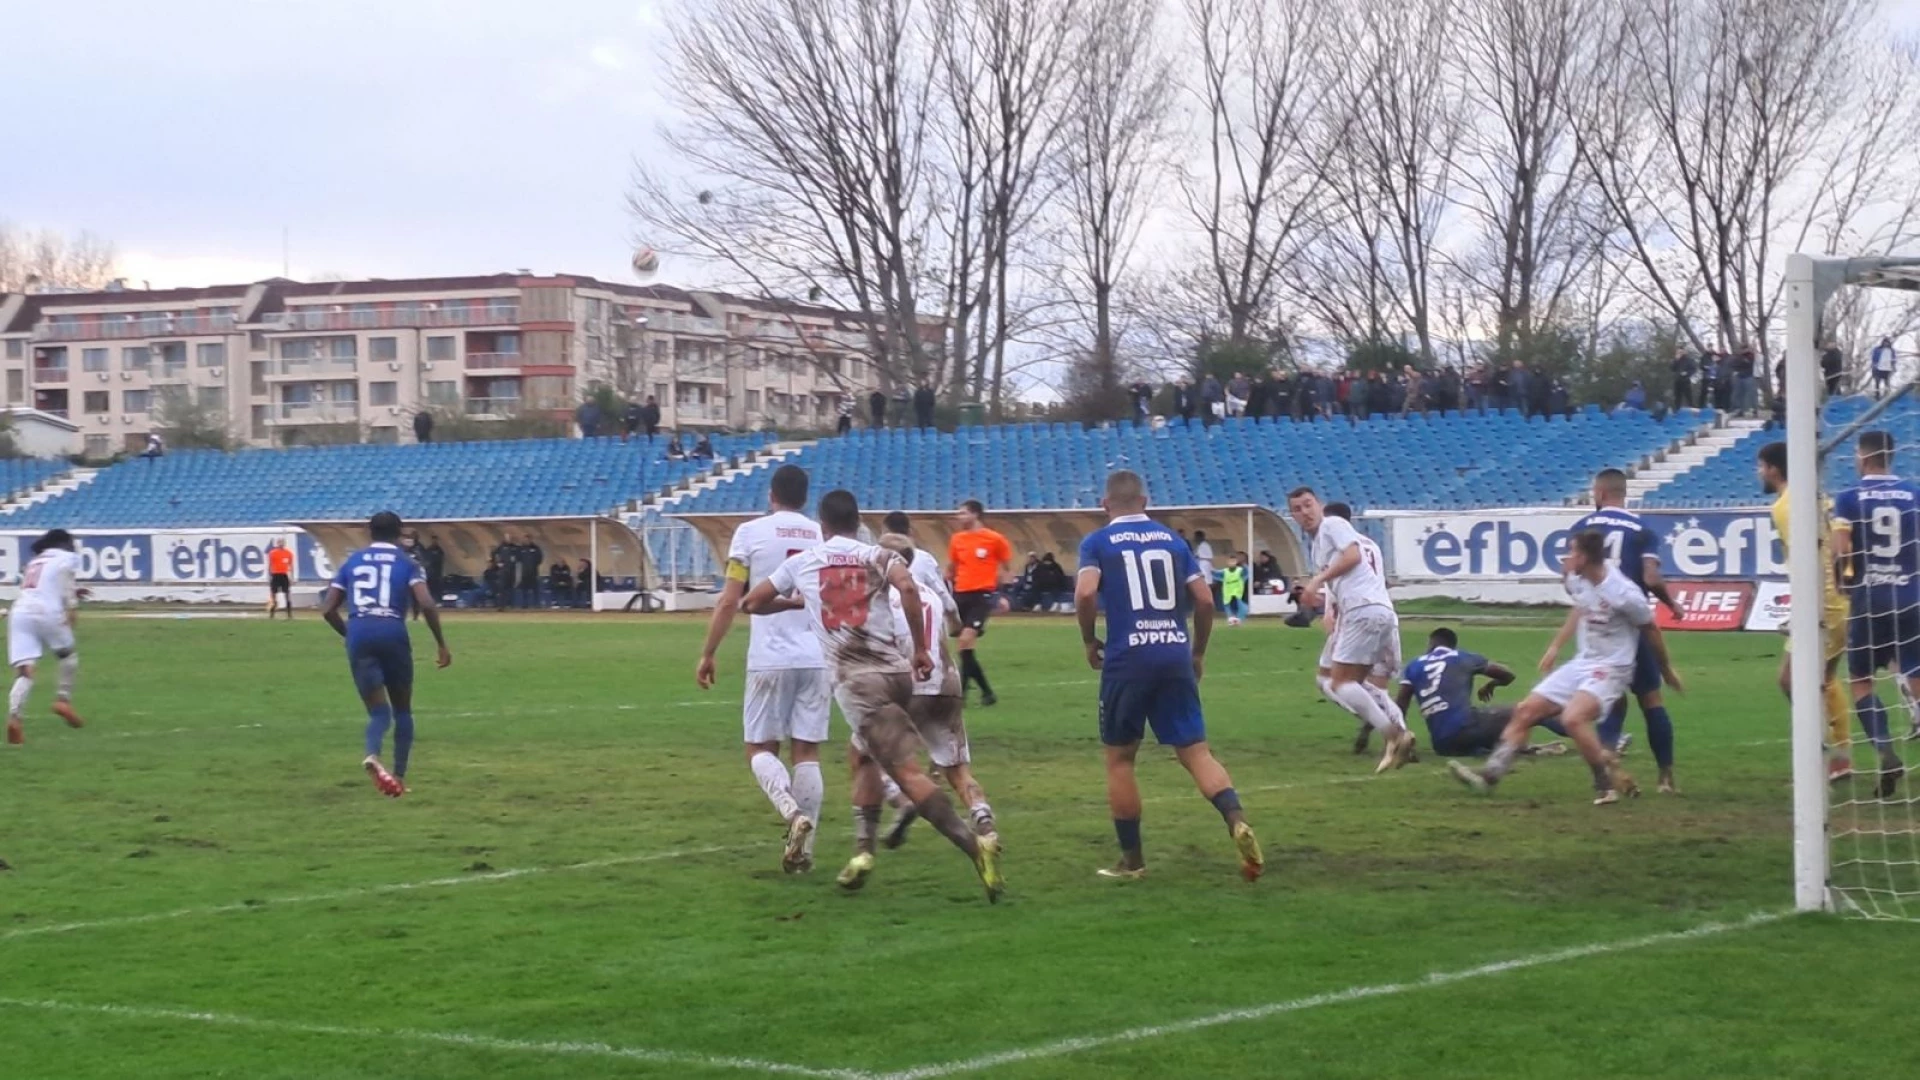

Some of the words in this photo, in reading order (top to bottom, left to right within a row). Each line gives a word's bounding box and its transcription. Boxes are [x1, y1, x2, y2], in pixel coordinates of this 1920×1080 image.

[1423, 521, 1568, 575] efbe
[1671, 518, 1789, 575] efb
[1872, 506, 1901, 558] 9
[74, 539, 141, 580] bet
[171, 538, 273, 579] efbe
[353, 564, 392, 607] 21
[1122, 549, 1176, 611] 10
[1675, 591, 1741, 612] LIFE
[1682, 612, 1733, 622] OSPITAL
[1128, 631, 1187, 647] БУРГАС
[1419, 661, 1447, 697] 3
